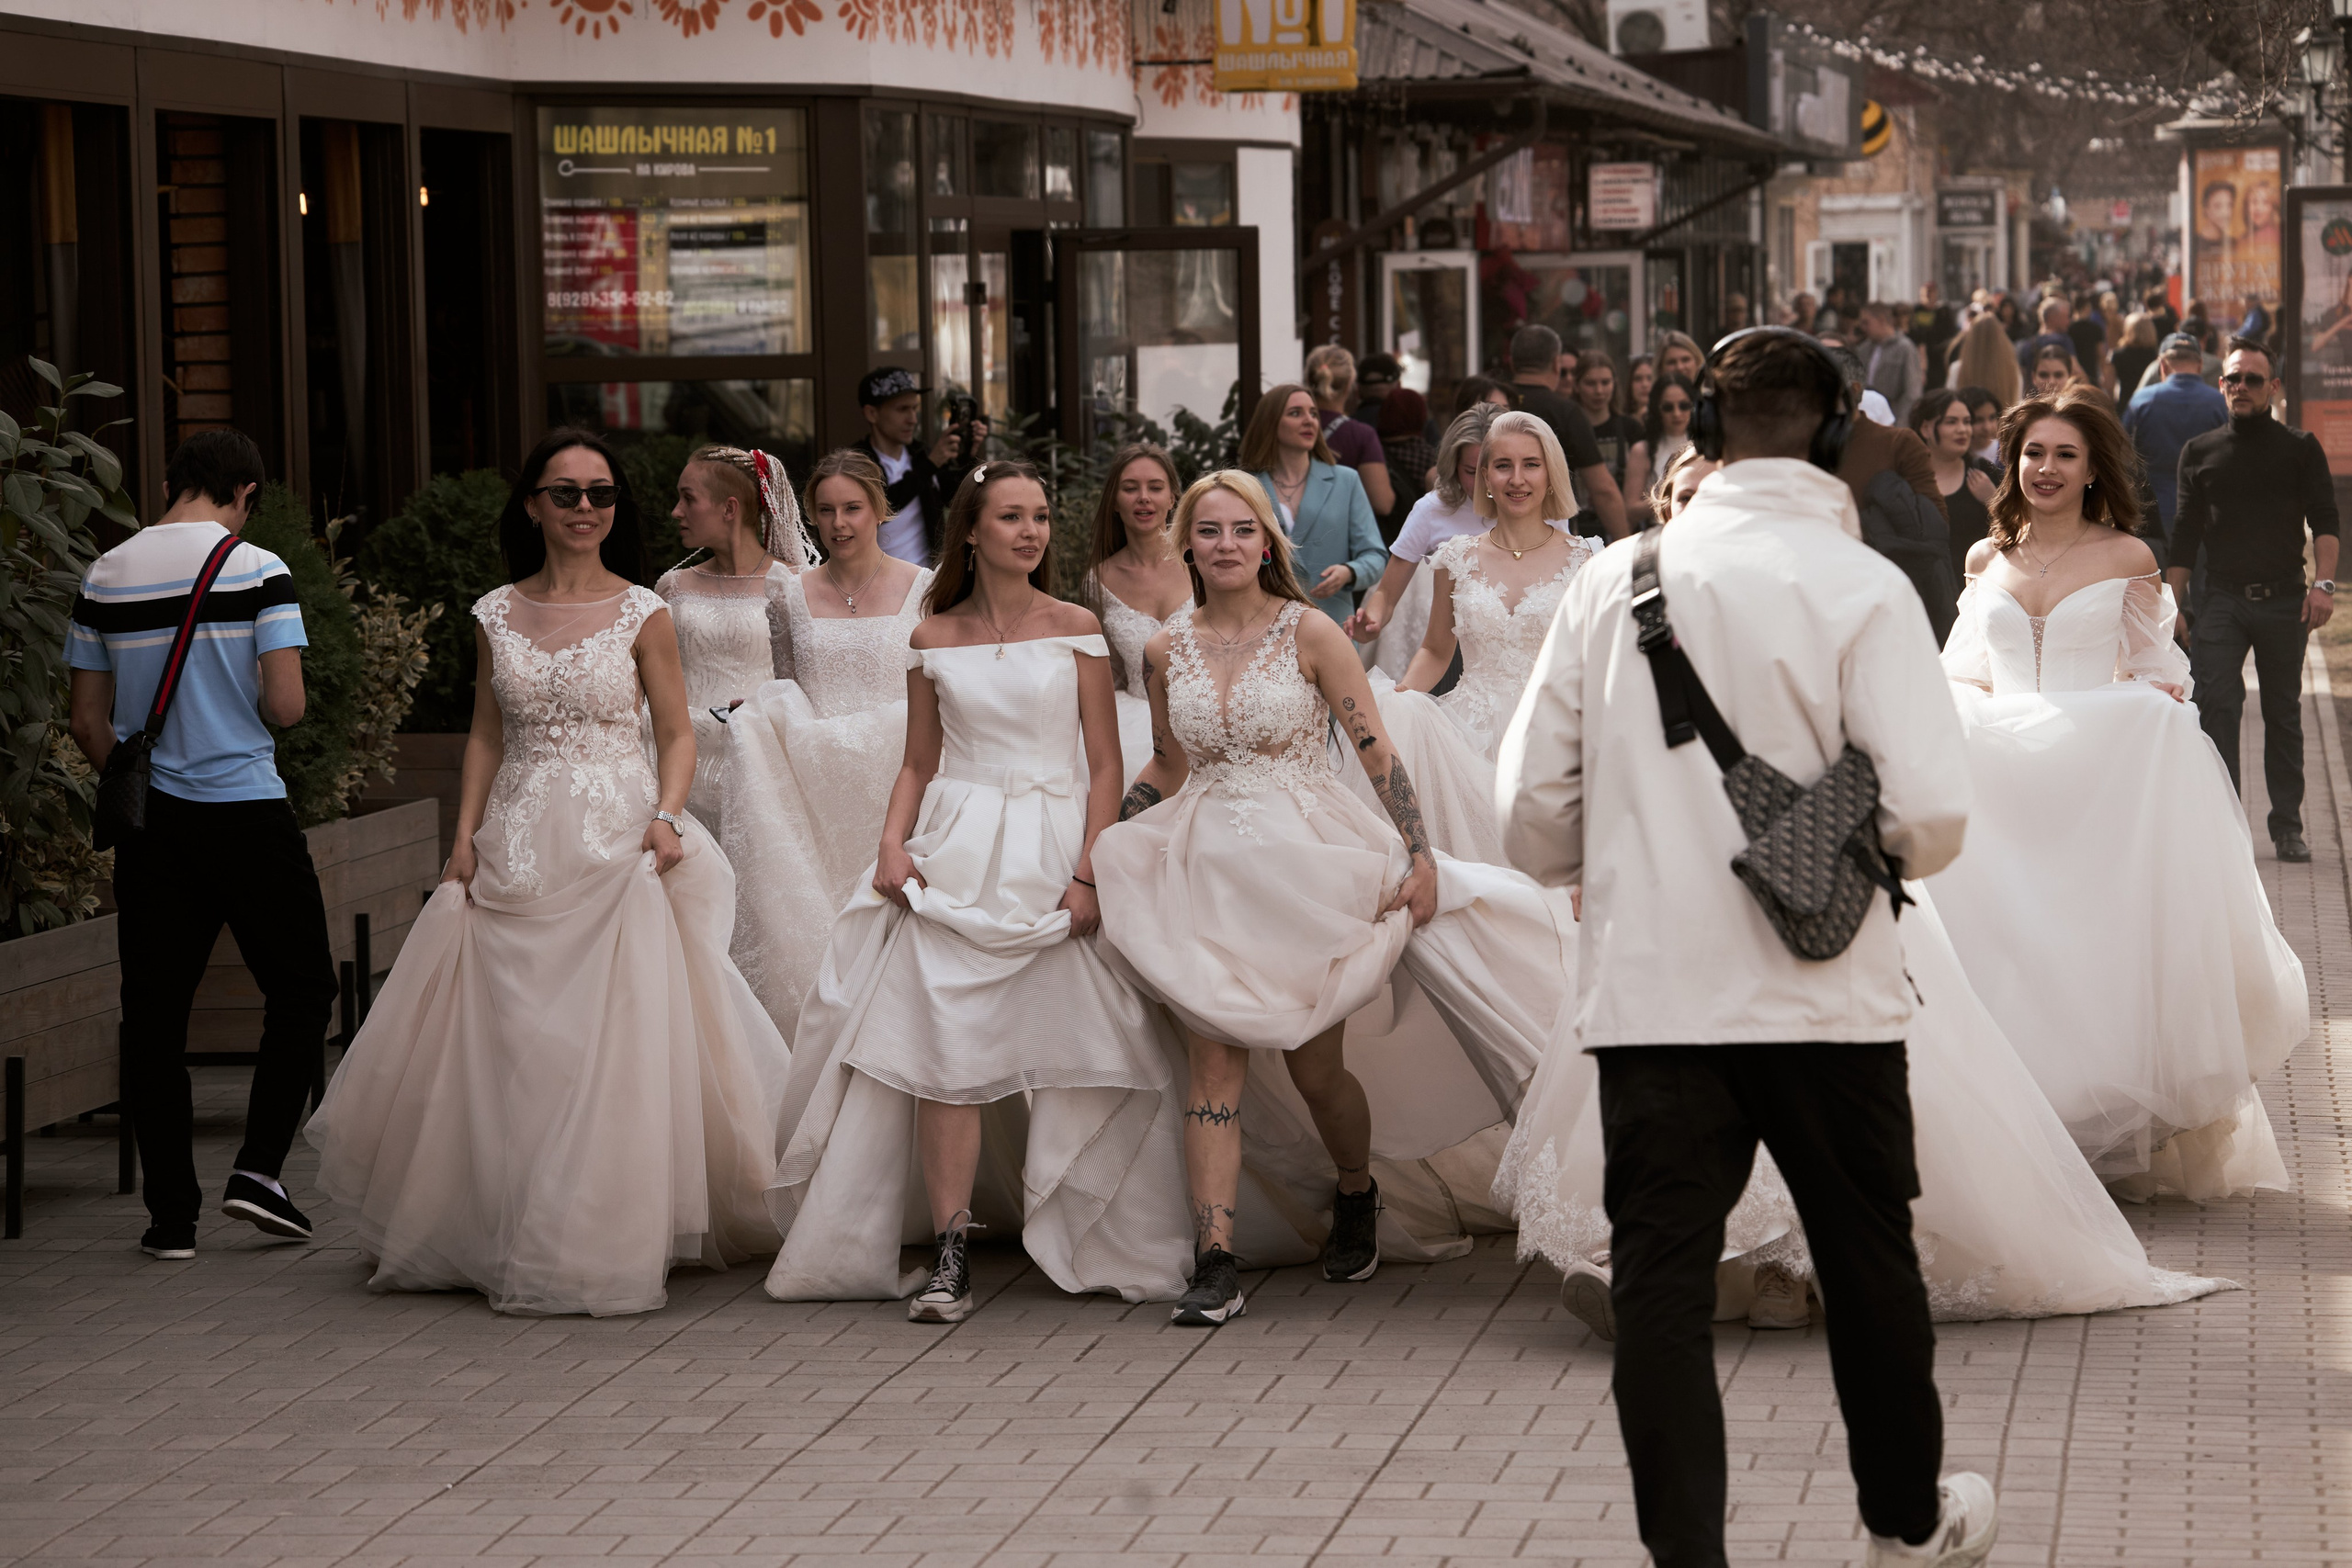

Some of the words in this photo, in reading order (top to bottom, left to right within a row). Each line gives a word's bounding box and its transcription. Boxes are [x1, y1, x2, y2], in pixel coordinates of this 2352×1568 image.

[1217, 50, 1349, 72] ШАШЛЫЧНАЯ
[553, 125, 728, 154] ШАШЛЫЧНАЯ
[736, 125, 776, 153] №1
[636, 163, 650, 176] НА
[653, 163, 695, 176] КИРОВА
